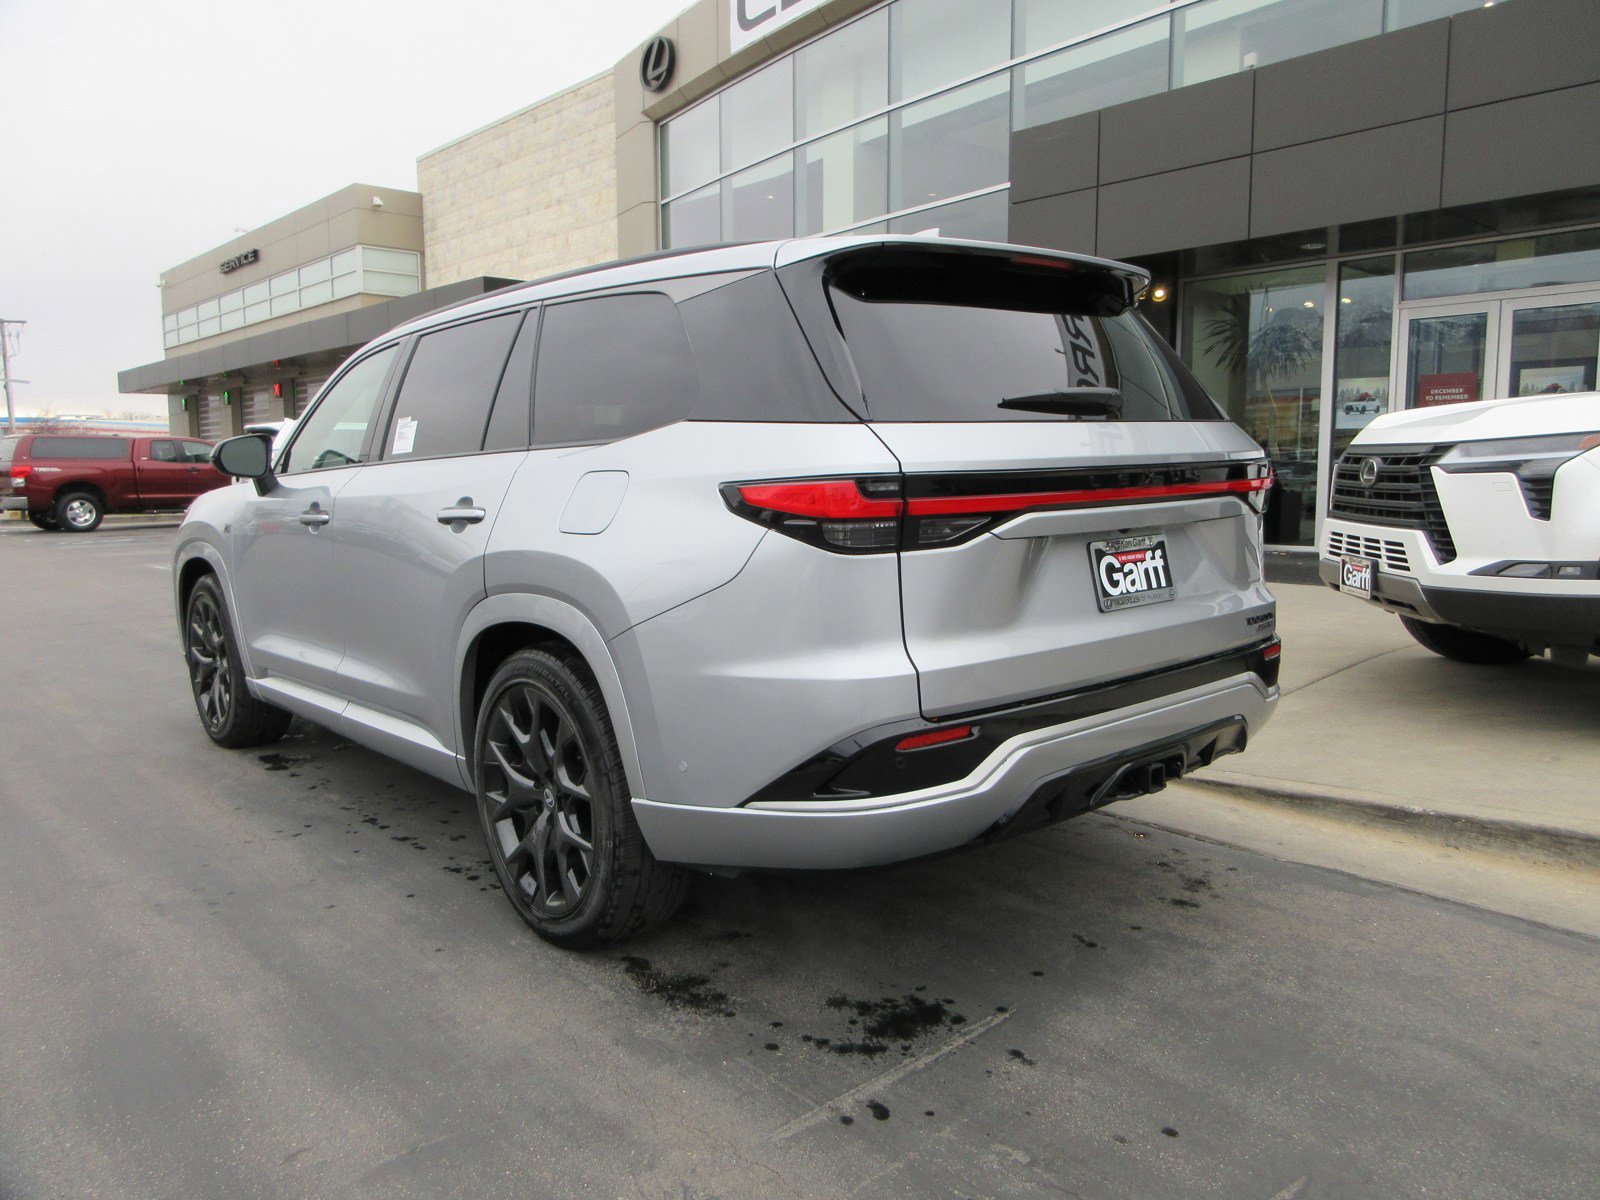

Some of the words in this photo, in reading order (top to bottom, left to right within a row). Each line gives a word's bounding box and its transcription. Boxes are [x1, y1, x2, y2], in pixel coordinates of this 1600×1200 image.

[218, 248, 259, 274] SERVICE
[1430, 387, 1464, 395] DECEMBER
[1099, 549, 1167, 596] Garff
[1343, 563, 1370, 590] Garff
